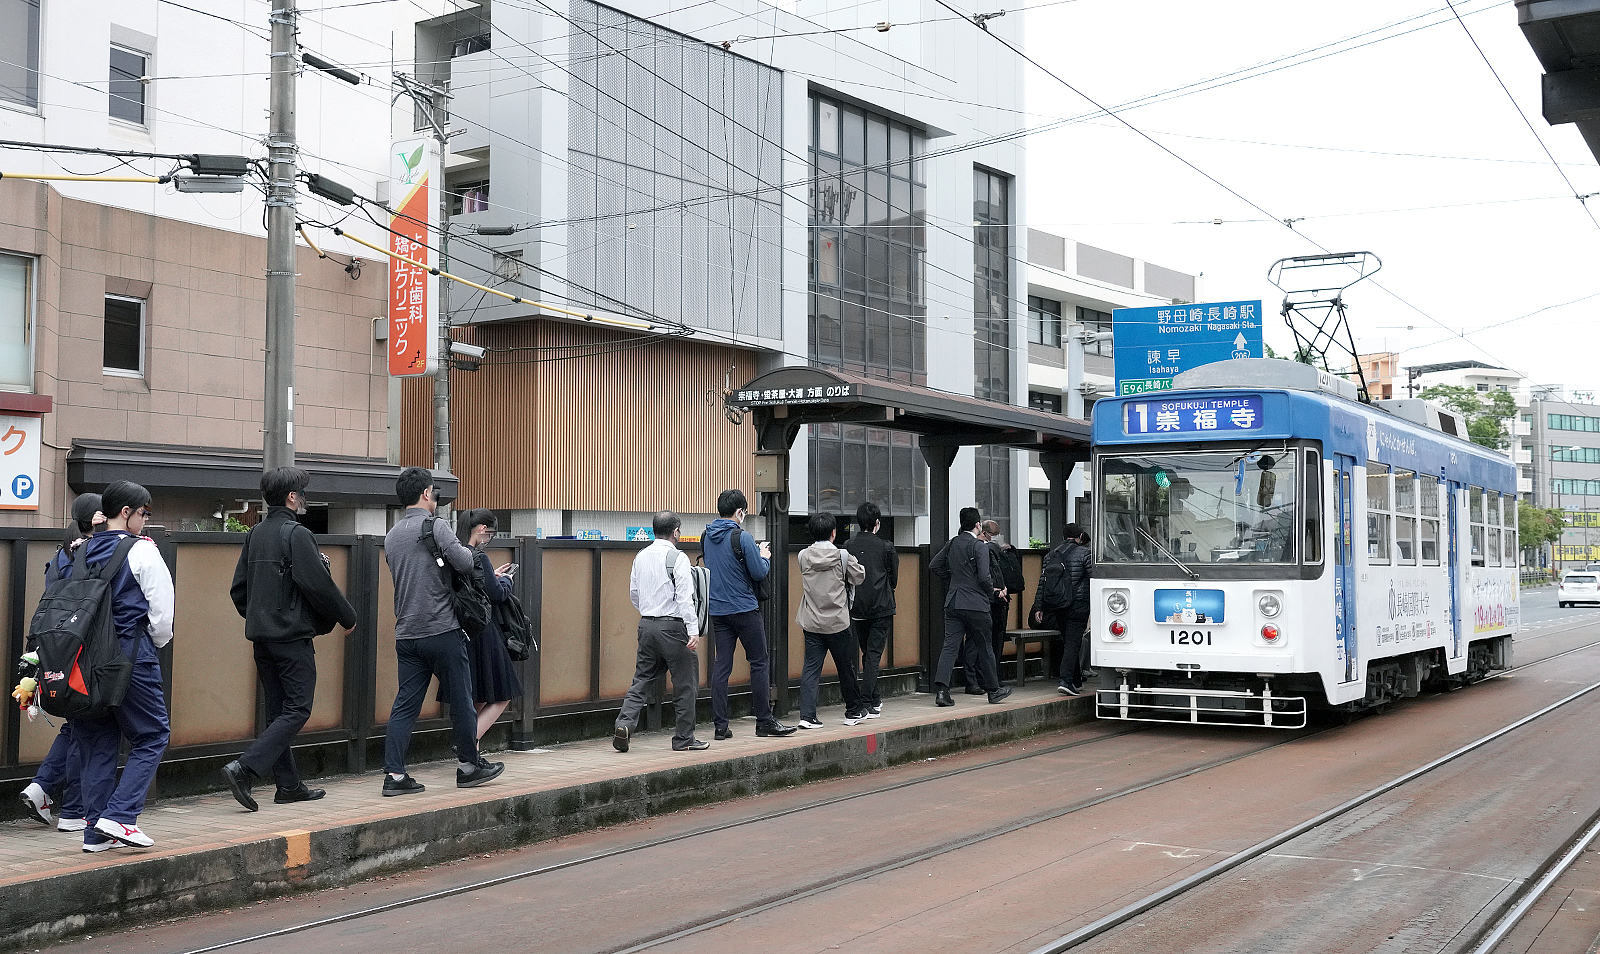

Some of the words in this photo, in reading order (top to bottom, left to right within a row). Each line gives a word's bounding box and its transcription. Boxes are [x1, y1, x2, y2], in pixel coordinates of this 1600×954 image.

[394, 234, 409, 356] 矯正クリニック
[1158, 325, 1202, 334] Nomozaki
[1207, 323, 1240, 332] Nagasaki
[416, 360, 425, 368] 2F
[1149, 365, 1179, 375] Isahaya
[1123, 383, 1143, 394] E96
[1144, 379, 1173, 390] 長崎バ
[807, 386, 823, 398] 方面
[826, 385, 850, 397] のりば
[1161, 401, 1208, 411] SOFUKUJI
[1211, 399, 1250, 409] TEMPLE
[1135, 404, 1148, 432] 1
[1156, 408, 1256, 431] 崇福寺
[1, 425, 26, 456] ク
[17, 478, 31, 496] P
[1170, 630, 1212, 646] 1201
[50, 690, 57, 698] 17
